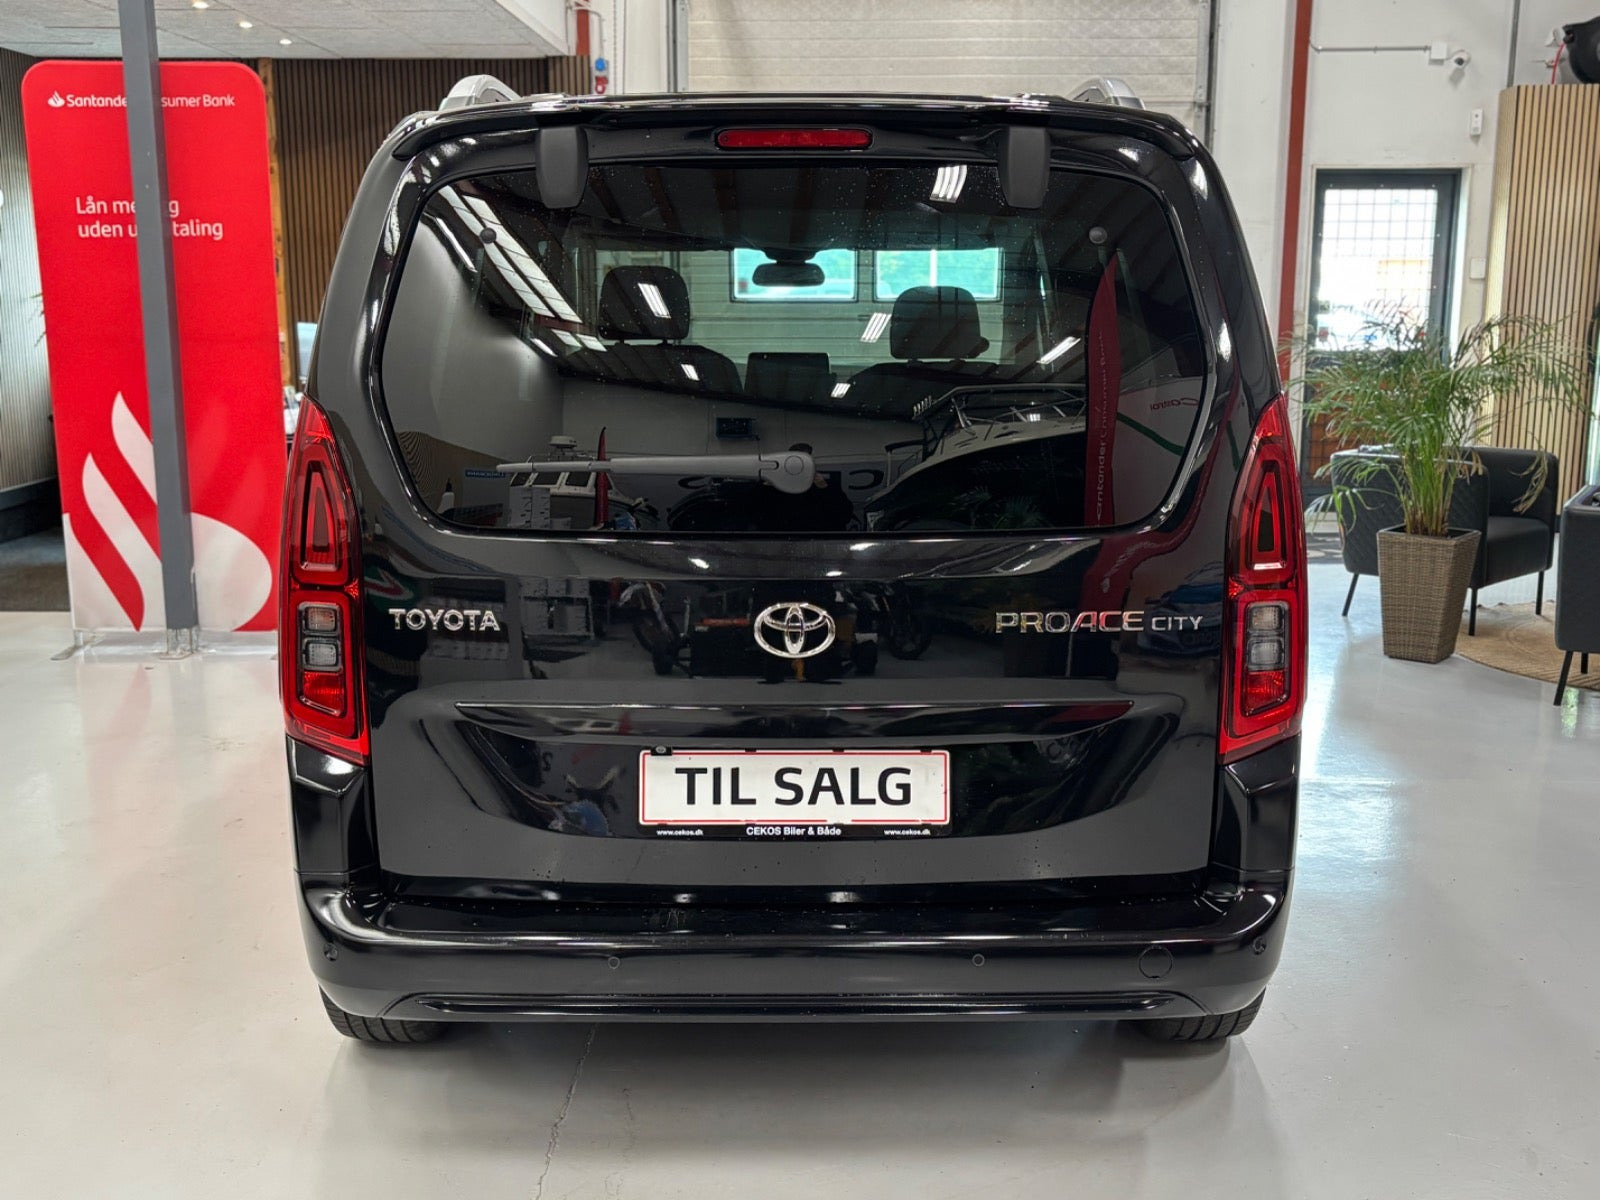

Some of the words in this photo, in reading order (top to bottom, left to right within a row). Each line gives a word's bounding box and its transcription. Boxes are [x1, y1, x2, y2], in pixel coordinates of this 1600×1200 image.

[66, 94, 127, 107] Santande
[202, 93, 235, 107] Bank
[76, 195, 108, 214] Lån
[78, 219, 123, 238] uden
[388, 608, 500, 631] TOYOTA
[995, 611, 1145, 633] PROACE
[1151, 616, 1203, 631] CITY
[675, 767, 757, 805] TIL
[774, 767, 912, 805] SALG
[746, 826, 781, 836] CEKOS
[783, 826, 805, 836] Biler
[807, 826, 815, 836] &
[817, 826, 842, 836] Både
[883, 828, 931, 836] www.cekos.dk
